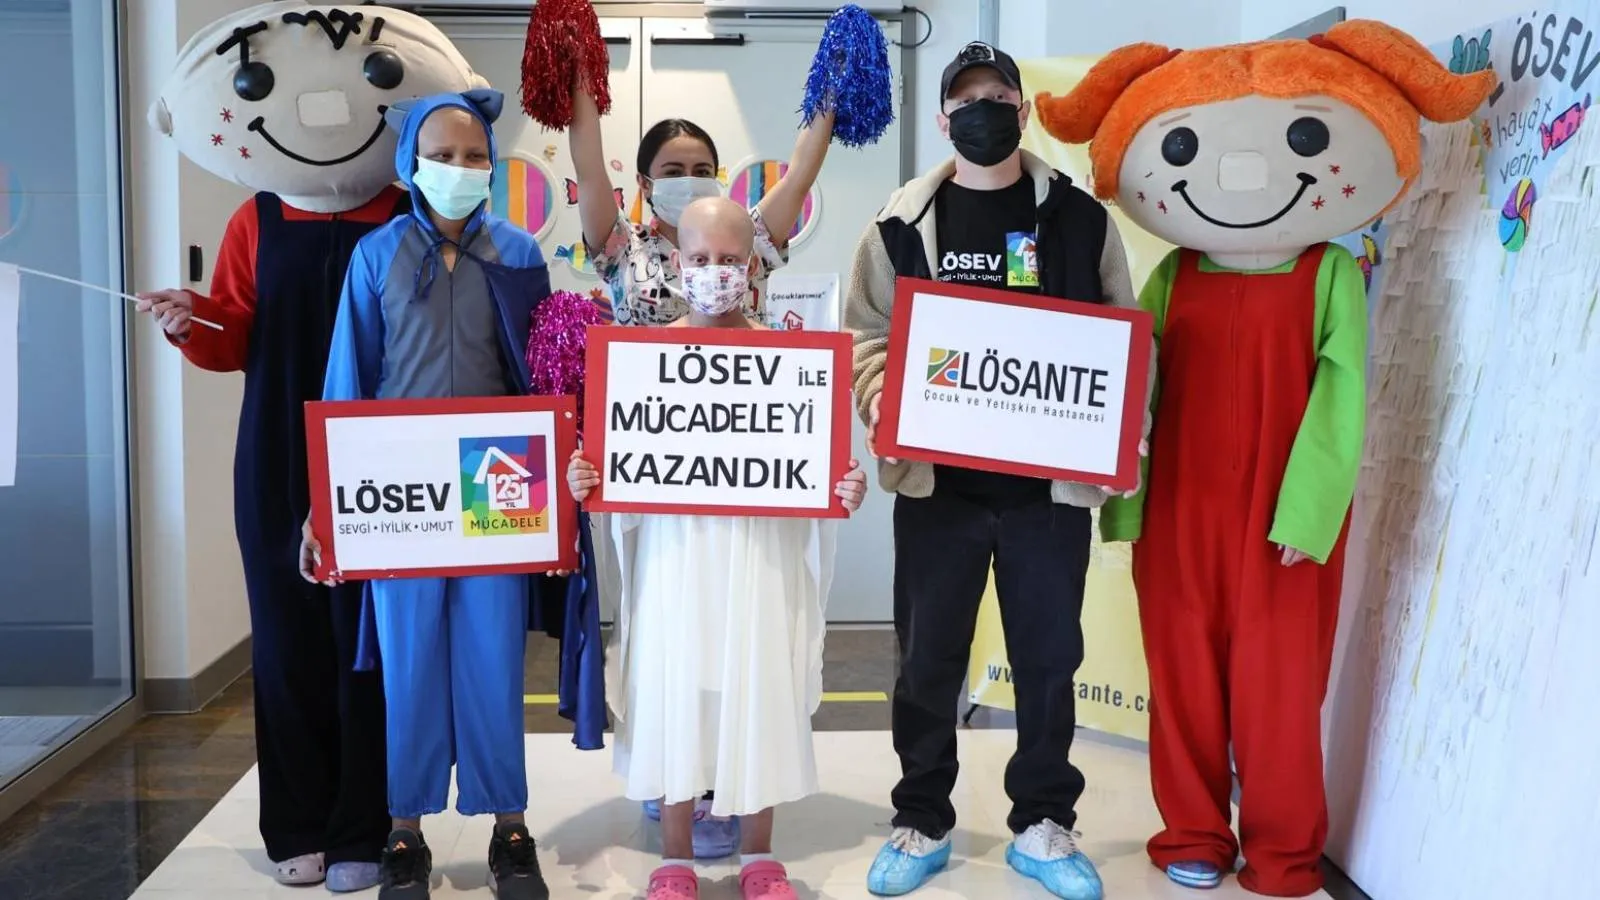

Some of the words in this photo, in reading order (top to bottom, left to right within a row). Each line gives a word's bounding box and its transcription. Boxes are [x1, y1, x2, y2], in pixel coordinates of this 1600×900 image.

[1488, 11, 1600, 107] ÖSEV
[1496, 96, 1553, 148] hayat
[1499, 148, 1539, 184] verir
[938, 251, 1002, 272] ÖSEV
[982, 274, 1003, 282] UMUT
[659, 345, 782, 386] LÖSEV
[798, 366, 827, 387] İLE
[960, 348, 1109, 408] LÖSANTE
[611, 396, 814, 434] MÜCADELEYİ
[924, 390, 960, 403] Çocuk
[967, 397, 980, 406] ve
[986, 398, 1037, 415] Yetişkin
[1043, 406, 1105, 423] Hastanesi
[496, 474, 522, 499] 25
[610, 452, 817, 490] KAZANDIK.
[337, 480, 451, 514] LÖSEV
[339, 520, 371, 535] SEVGİ
[381, 519, 413, 533] İYİLİK
[421, 520, 454, 533] UMUT
[470, 516, 541, 530] MÜCADELE
